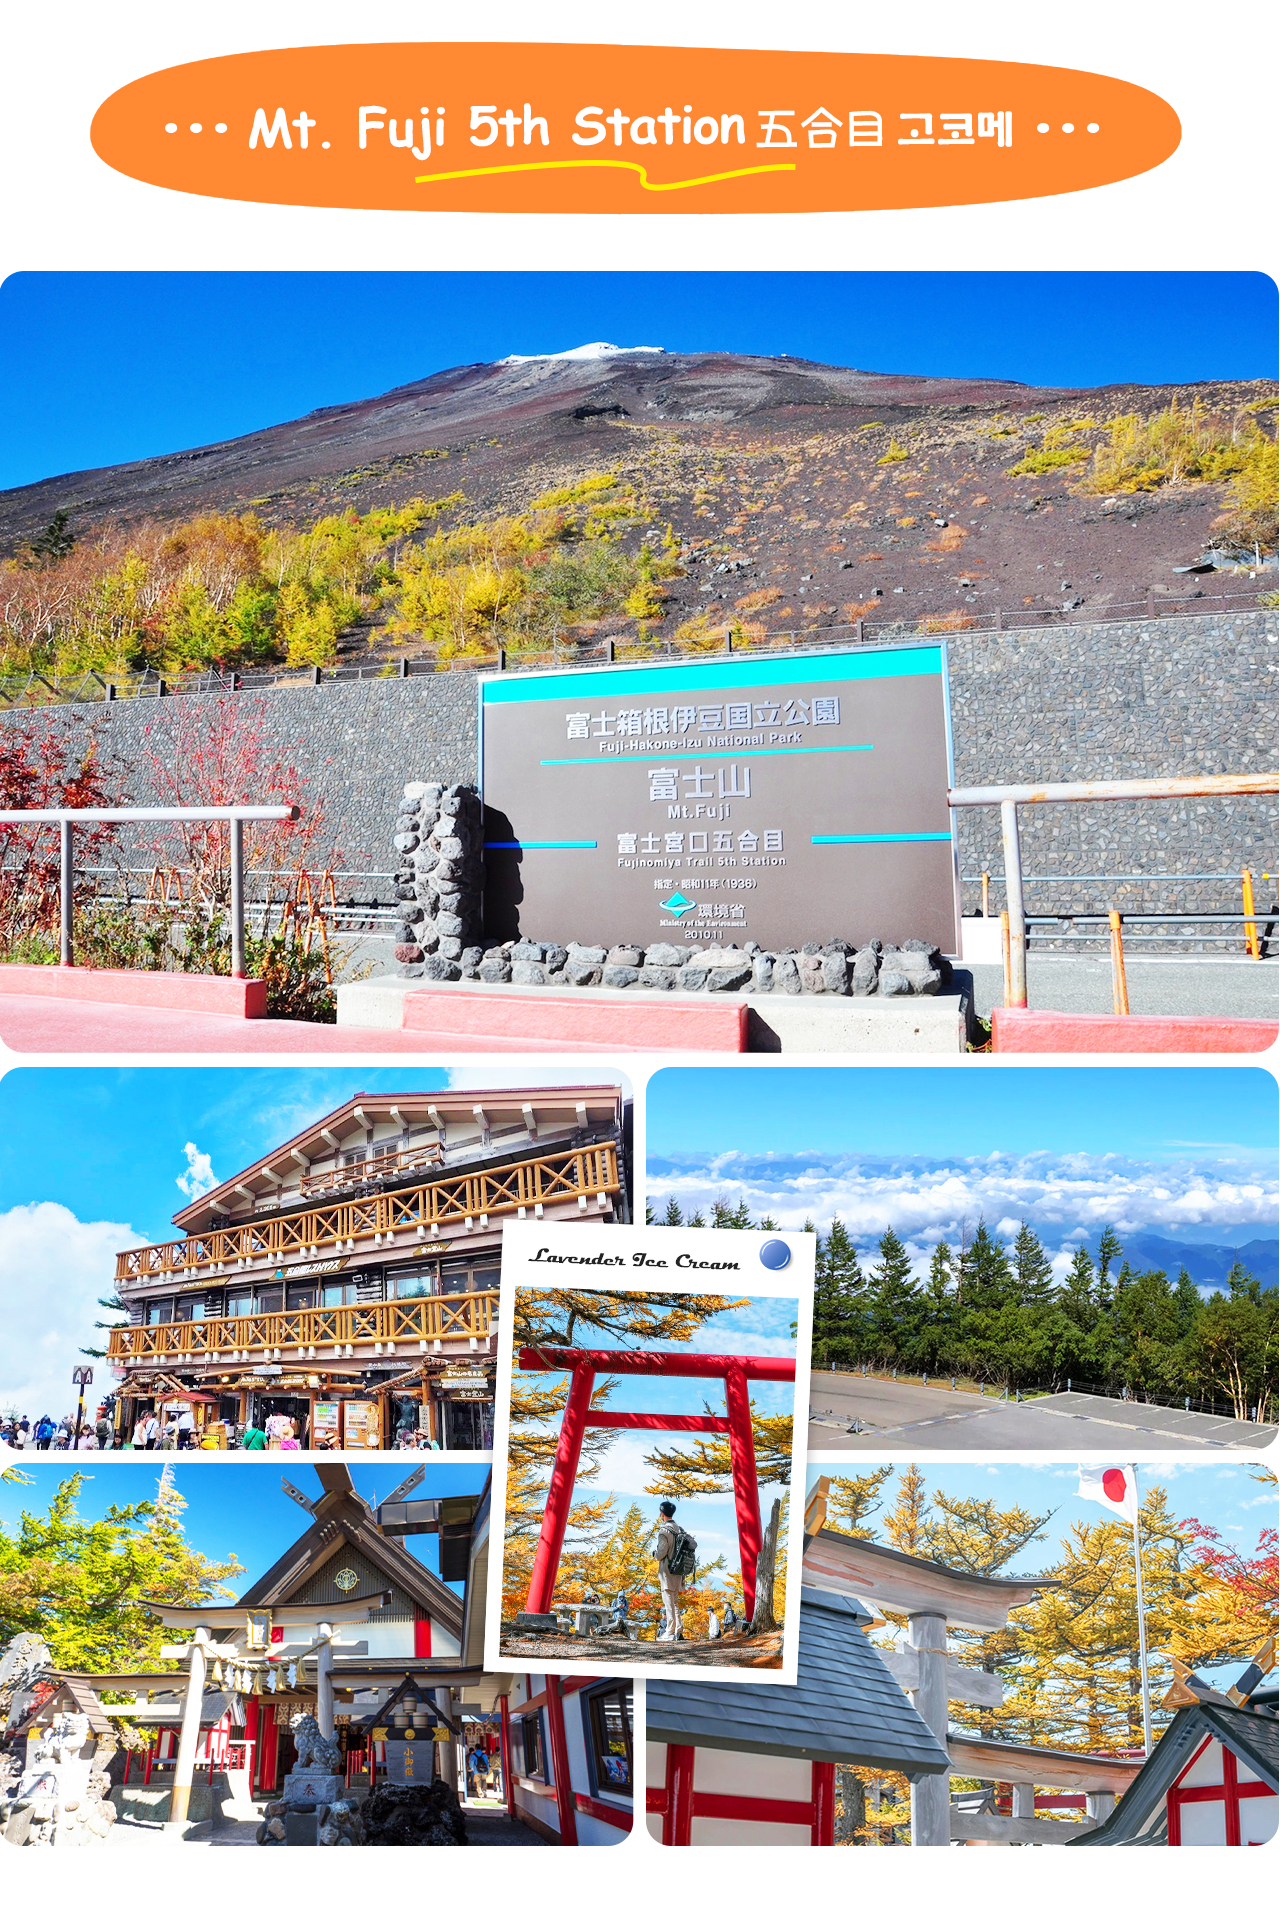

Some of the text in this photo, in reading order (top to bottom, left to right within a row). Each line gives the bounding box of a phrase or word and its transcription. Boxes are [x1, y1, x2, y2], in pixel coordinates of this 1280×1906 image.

[565, 696, 841, 739] 富士箱根伊豆国立公園
[599, 731, 803, 754] Fuji-Hakone-Izu National Park
[648, 764, 752, 801] 富士山
[667, 803, 731, 821] Mt.Fuji
[617, 829, 784, 854] 富士宮口五合目
[617, 855, 787, 869] Fujinomiya Trail 5th Station
[698, 903, 747, 918] 環境省
[659, 919, 687, 929] Ministry
[694, 919, 705, 927] the
[706, 919, 748, 928] Environment
[685, 930, 724, 940] 2010.11
